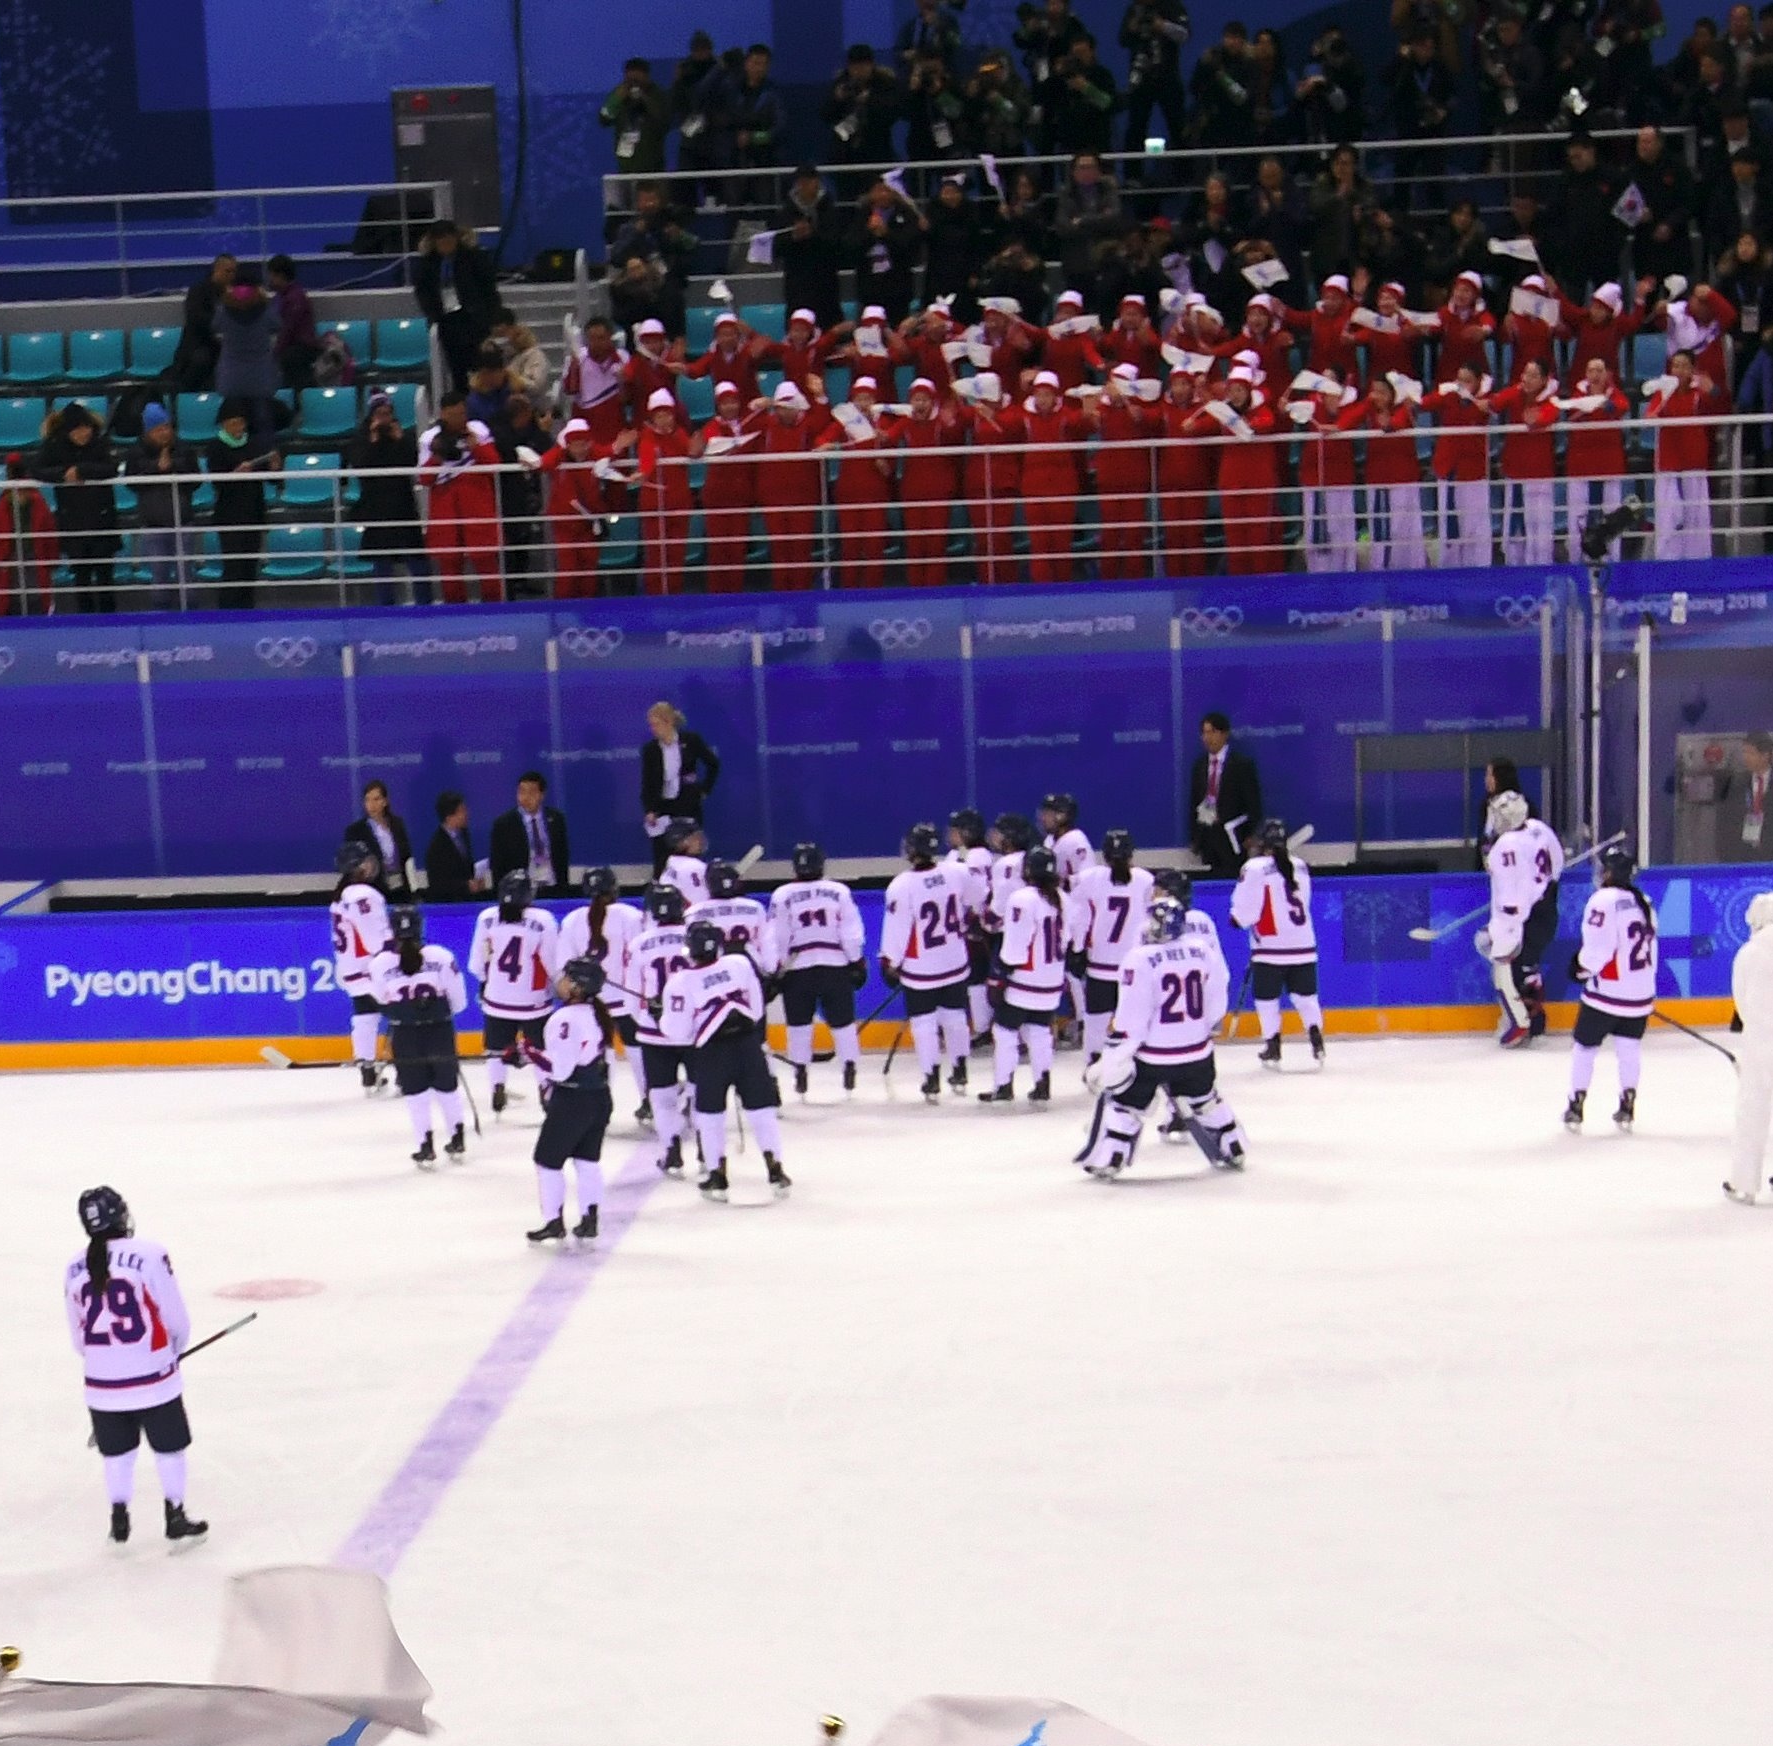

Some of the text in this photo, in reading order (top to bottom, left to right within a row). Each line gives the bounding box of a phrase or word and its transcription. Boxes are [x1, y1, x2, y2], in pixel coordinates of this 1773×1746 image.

[1408, 604, 1449, 622] 2018
[784, 627, 825, 643] 2018
[976, 615, 1135, 640] PyeongChang 2018
[173, 646, 213, 662] 2018
[360, 635, 517, 659] PyeongChang 2018
[1501, 850, 1516, 867] 31
[920, 893, 964, 950] 24
[1108, 896, 1130, 943] 7
[1588, 909, 1605, 928] 23
[498, 935, 523, 983] 4
[44, 960, 307, 1007] PyeongChang
[1159, 969, 1204, 1024] 20
[558, 1021, 570, 1040] 3
[80, 1278, 146, 1346] 29
